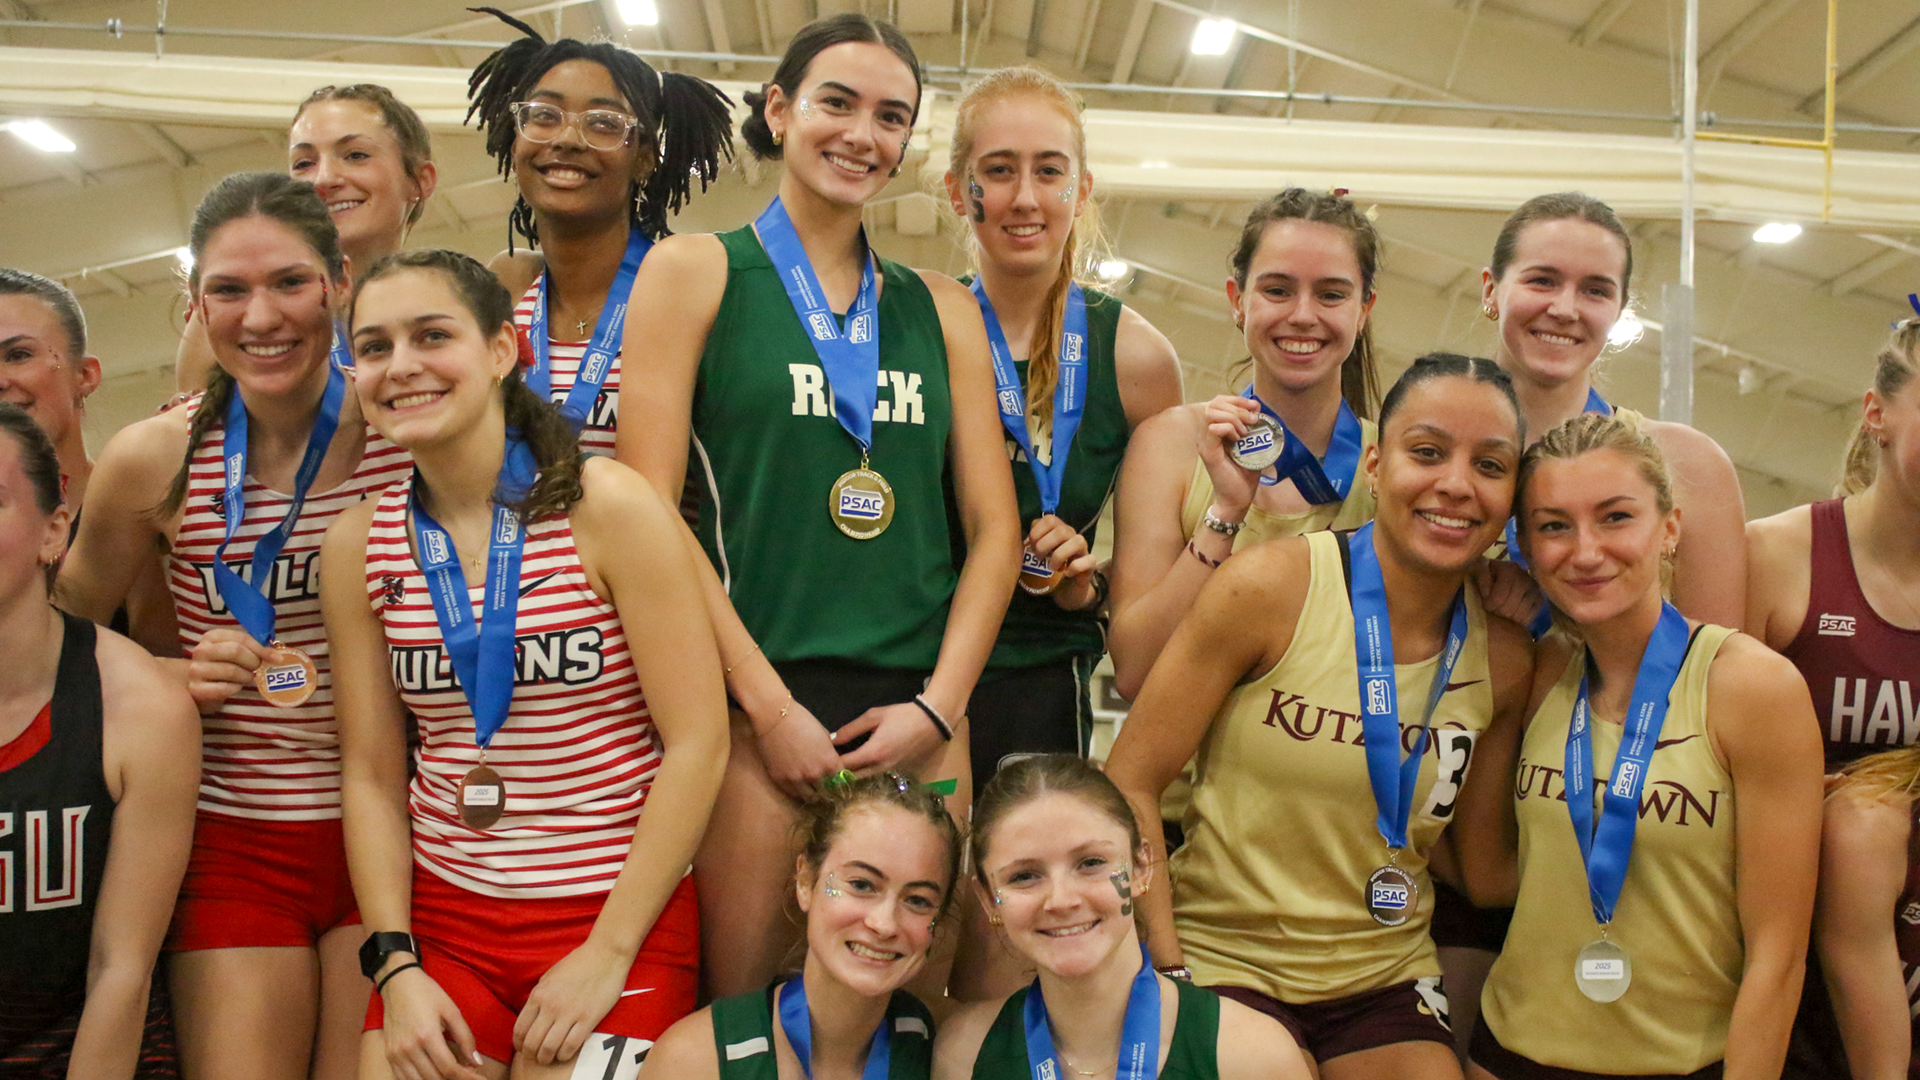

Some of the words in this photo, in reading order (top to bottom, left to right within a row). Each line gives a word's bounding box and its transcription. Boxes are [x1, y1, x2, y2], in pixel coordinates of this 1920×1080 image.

[814, 314, 831, 339] PSAC
[856, 315, 866, 342] PSAC
[1068, 334, 1077, 360] PSAC
[587, 354, 604, 383] PSAC
[788, 363, 925, 425] RCK
[1004, 391, 1018, 415] PSAC
[1237, 433, 1272, 450] PSAC
[857, 471, 873, 479] TRACK
[877, 479, 890, 494] FIELD
[841, 496, 881, 511] PSAC
[503, 508, 514, 543] PSAC
[430, 531, 445, 562] PSAC
[1023, 553, 1047, 569] PSA
[501, 551, 510, 591] PENNSYLVANIA
[437, 570, 447, 595] ATHLETIC
[443, 595, 456, 628] CONFERENCE
[443, 568, 457, 607] PENNSYLVANIA
[453, 607, 461, 623] STATE
[493, 575, 501, 610] CONFERENCE
[1372, 615, 1381, 648] CONFERENCE
[1819, 619, 1857, 632] PSAC
[1368, 634, 1376, 672] PENNSYLVANIA
[266, 670, 305, 685] PSAC
[1373, 681, 1385, 713] PSAC
[1630, 718, 1642, 755] PENNSYLVANIA
[1640, 702, 1648, 718] STATE
[1635, 733, 1645, 756] ATHLETIC
[1642, 702, 1655, 733] CONFERENCE
[1431, 735, 1472, 818] 3
[1618, 763, 1635, 796] PSAC
[1402, 873, 1413, 886] FIELD
[1373, 889, 1406, 902] PSAC
[1594, 962, 1611, 970] 2025
[1138, 1042, 1146, 1076] CONFERENCE
